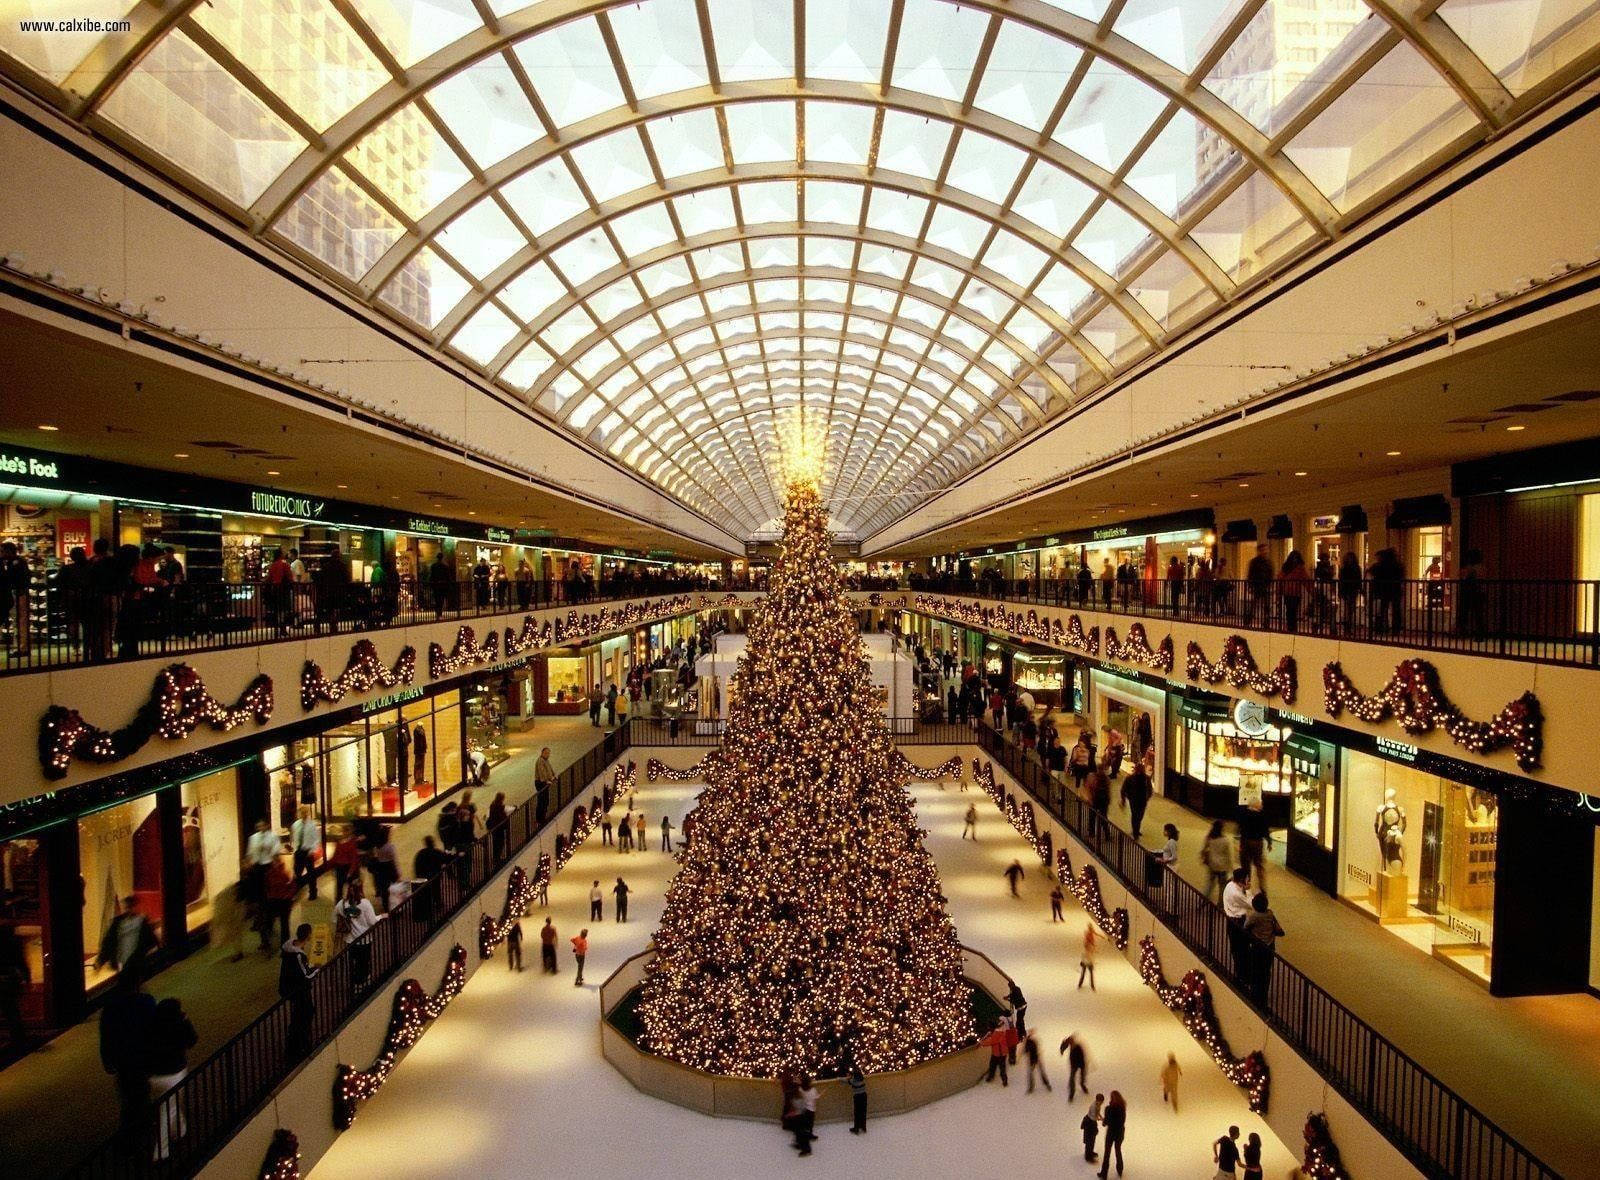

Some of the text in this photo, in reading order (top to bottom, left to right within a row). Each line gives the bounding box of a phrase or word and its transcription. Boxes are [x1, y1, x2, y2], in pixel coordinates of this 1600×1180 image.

[0, 454, 58, 478] te's Foot
[252, 491, 311, 517] FUTURETRONICS
[63, 531, 86, 543] BUY
